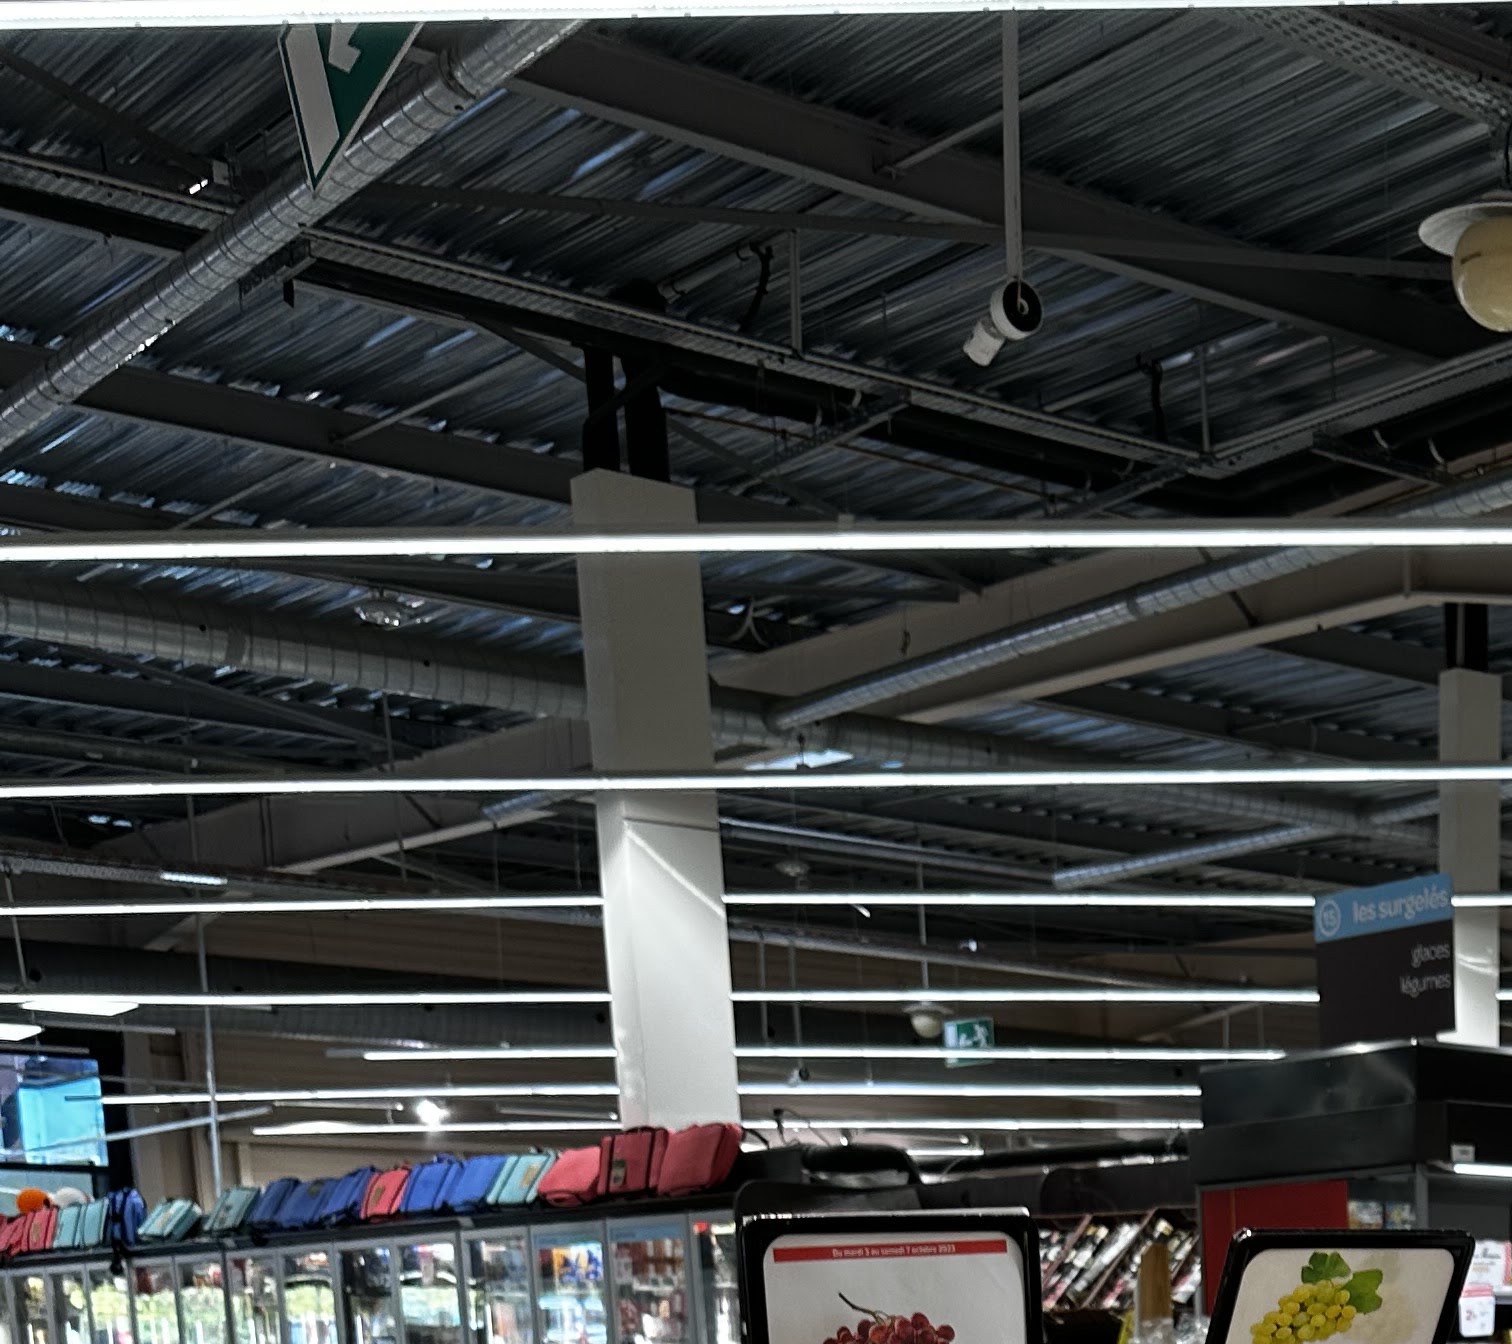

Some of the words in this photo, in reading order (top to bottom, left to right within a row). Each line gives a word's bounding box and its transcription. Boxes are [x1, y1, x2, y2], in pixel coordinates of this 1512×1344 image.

[1352, 900, 1377, 924] les
[1378, 885, 1448, 920] surgelés
[1411, 943, 1451, 969] glaces
